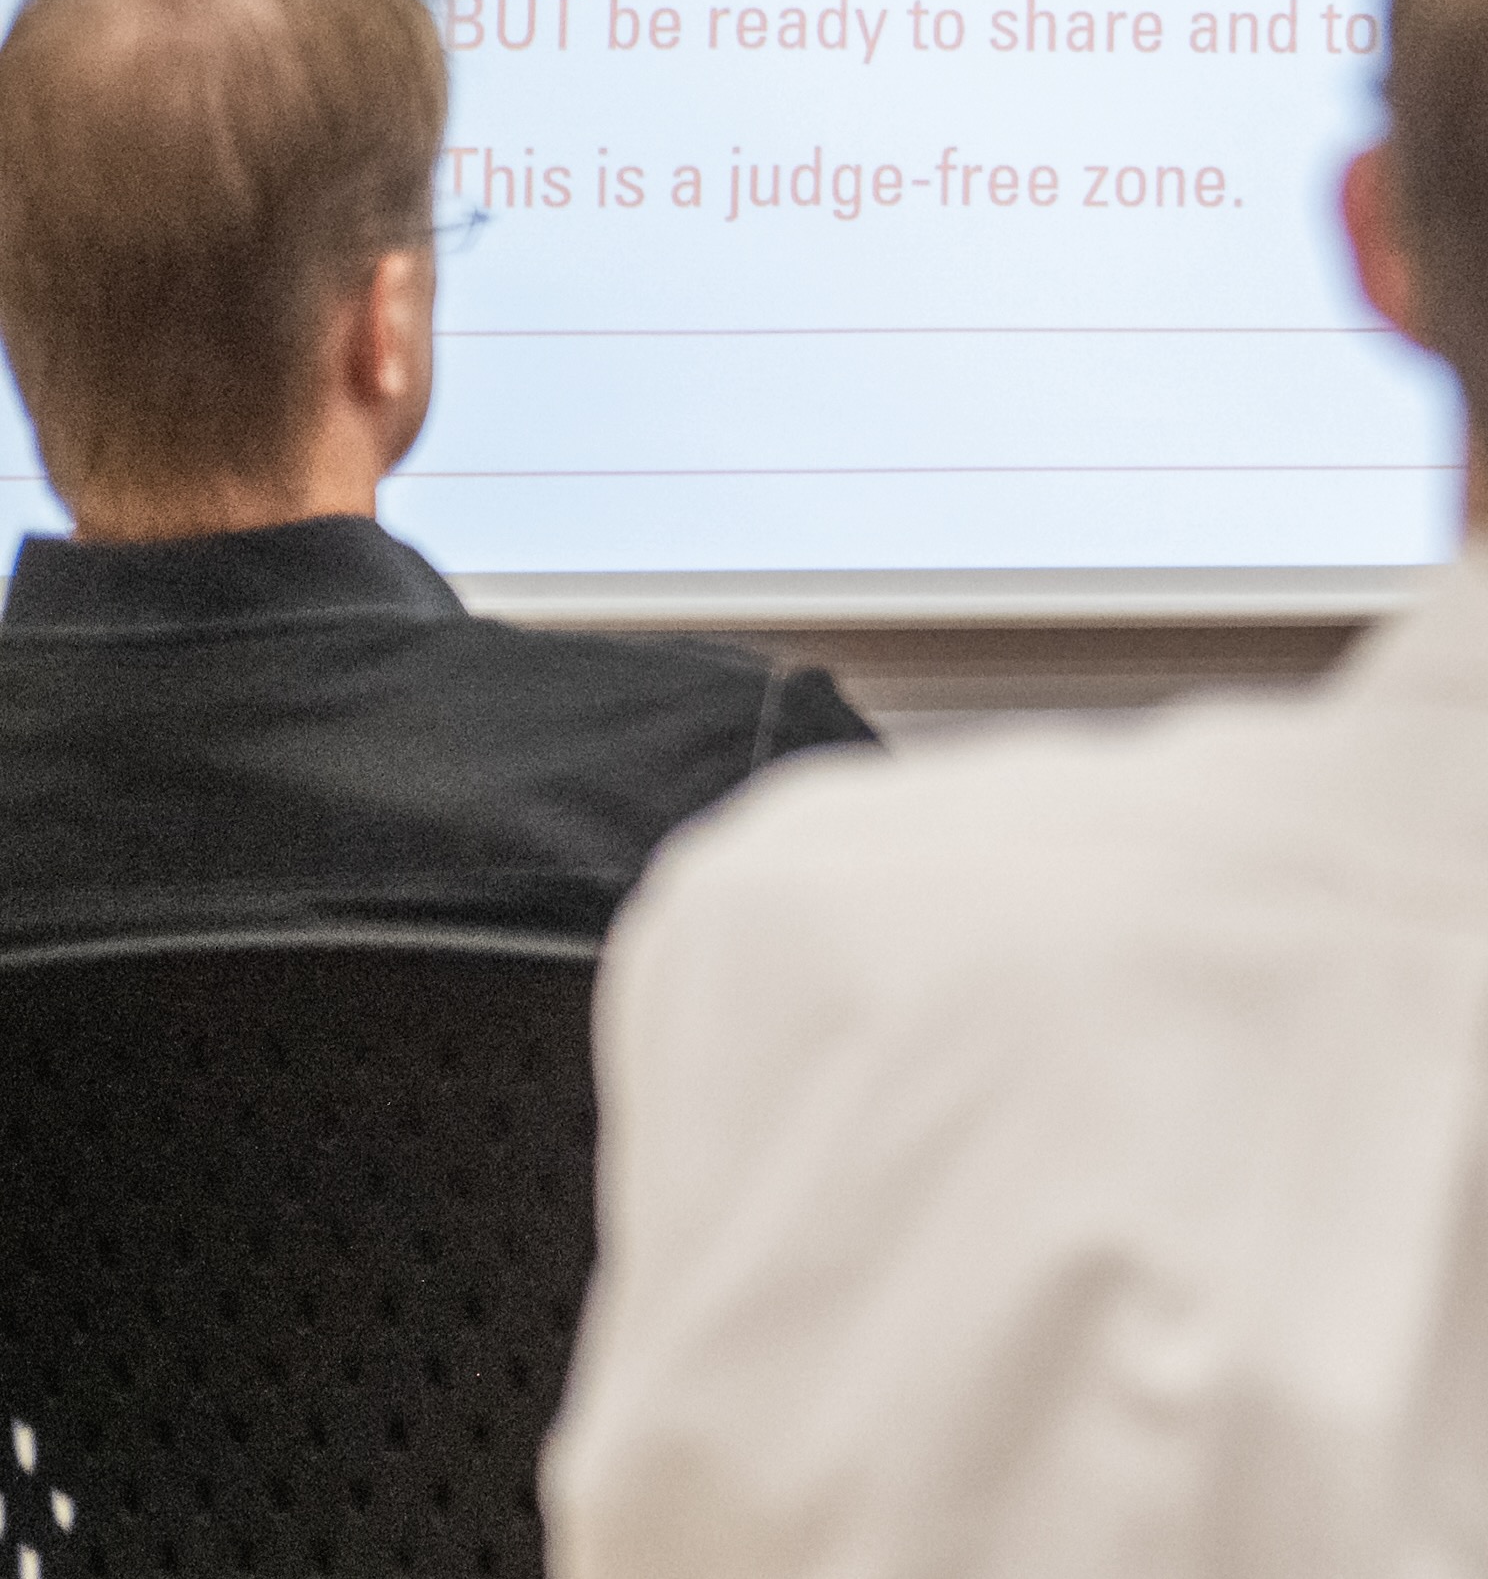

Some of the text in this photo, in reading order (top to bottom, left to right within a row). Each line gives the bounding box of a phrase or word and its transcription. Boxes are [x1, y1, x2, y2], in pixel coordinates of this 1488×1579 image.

[908, 1, 966, 53] to
[447, 146, 1242, 223] This is a judge-free zone.
